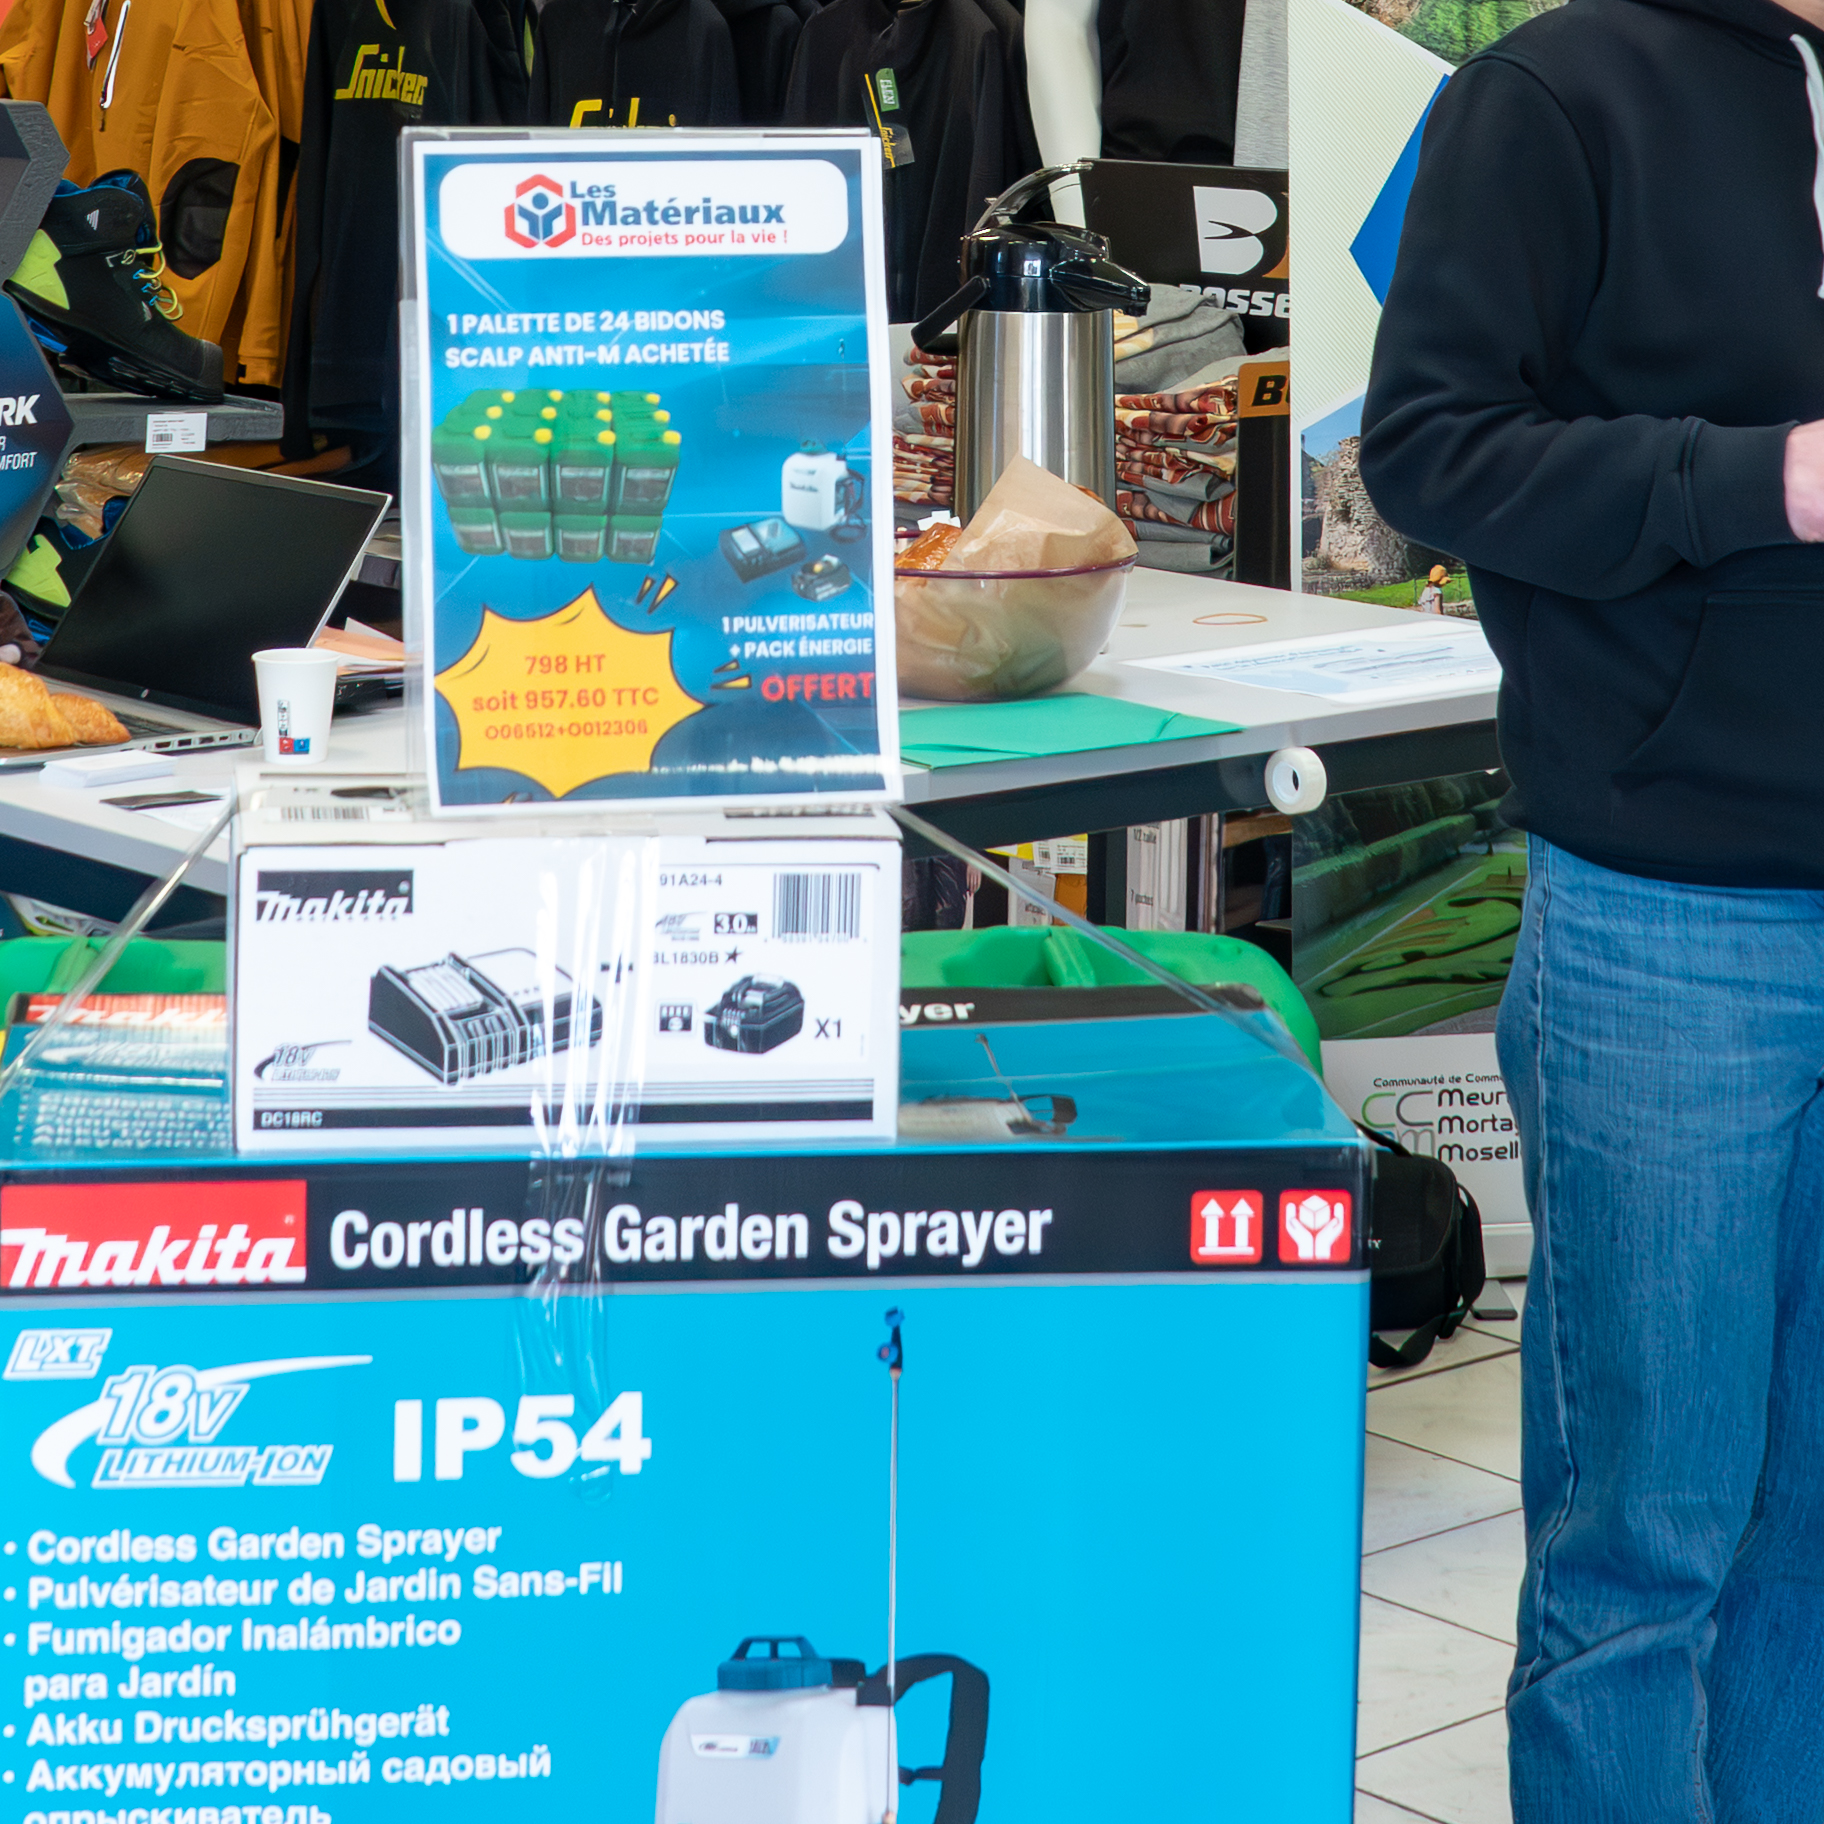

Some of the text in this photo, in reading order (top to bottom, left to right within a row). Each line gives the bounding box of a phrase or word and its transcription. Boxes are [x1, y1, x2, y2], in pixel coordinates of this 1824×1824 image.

[570, 180, 616, 200] Les
[581, 197, 785, 227] Matériaux
[581, 232, 613, 246] Des
[618, 231, 678, 248] projets
[684, 232, 725, 247] pour
[731, 230, 745, 244] la
[750, 230, 776, 244] vie
[447, 309, 725, 334] 1 PALETTE DE 24 BIDONS
[445, 337, 730, 368] SCALP ANTI-M ACHETÉE
[733, 613, 874, 634] PULVERISATEUR
[744, 641, 796, 658] PACK
[799, 634, 873, 657] ÉNERGIE
[525, 654, 606, 675] 798 HT
[473, 687, 660, 713] soit 957.60 TTC
[761, 672, 874, 704] OFFERT
[814, 1018, 843, 1040] X1
[1373, 1075, 1445, 1088] Communauté
[1438, 1088, 1507, 1107] Meur
[1438, 1140, 1519, 1162] Mosell
[330, 1206, 585, 1271] Cordless
[603, 1204, 813, 1263] Garden
[826, 1200, 1052, 1269] Sprayer
[393, 1391, 652, 1483] IP54
[27, 1523, 502, 1565] Cordless Garden Sprayer
[27, 1560, 623, 1610] Pulvérisateur de Jardin Sans-Fil
[27, 1613, 462, 1662] Fumigador Inalámbrico
[23, 1662, 237, 1709] para Jardín
[26, 1702, 451, 1749] Akku Drucksprühgerät
[25, 1744, 552, 1798] Аккумуляторный садовый
